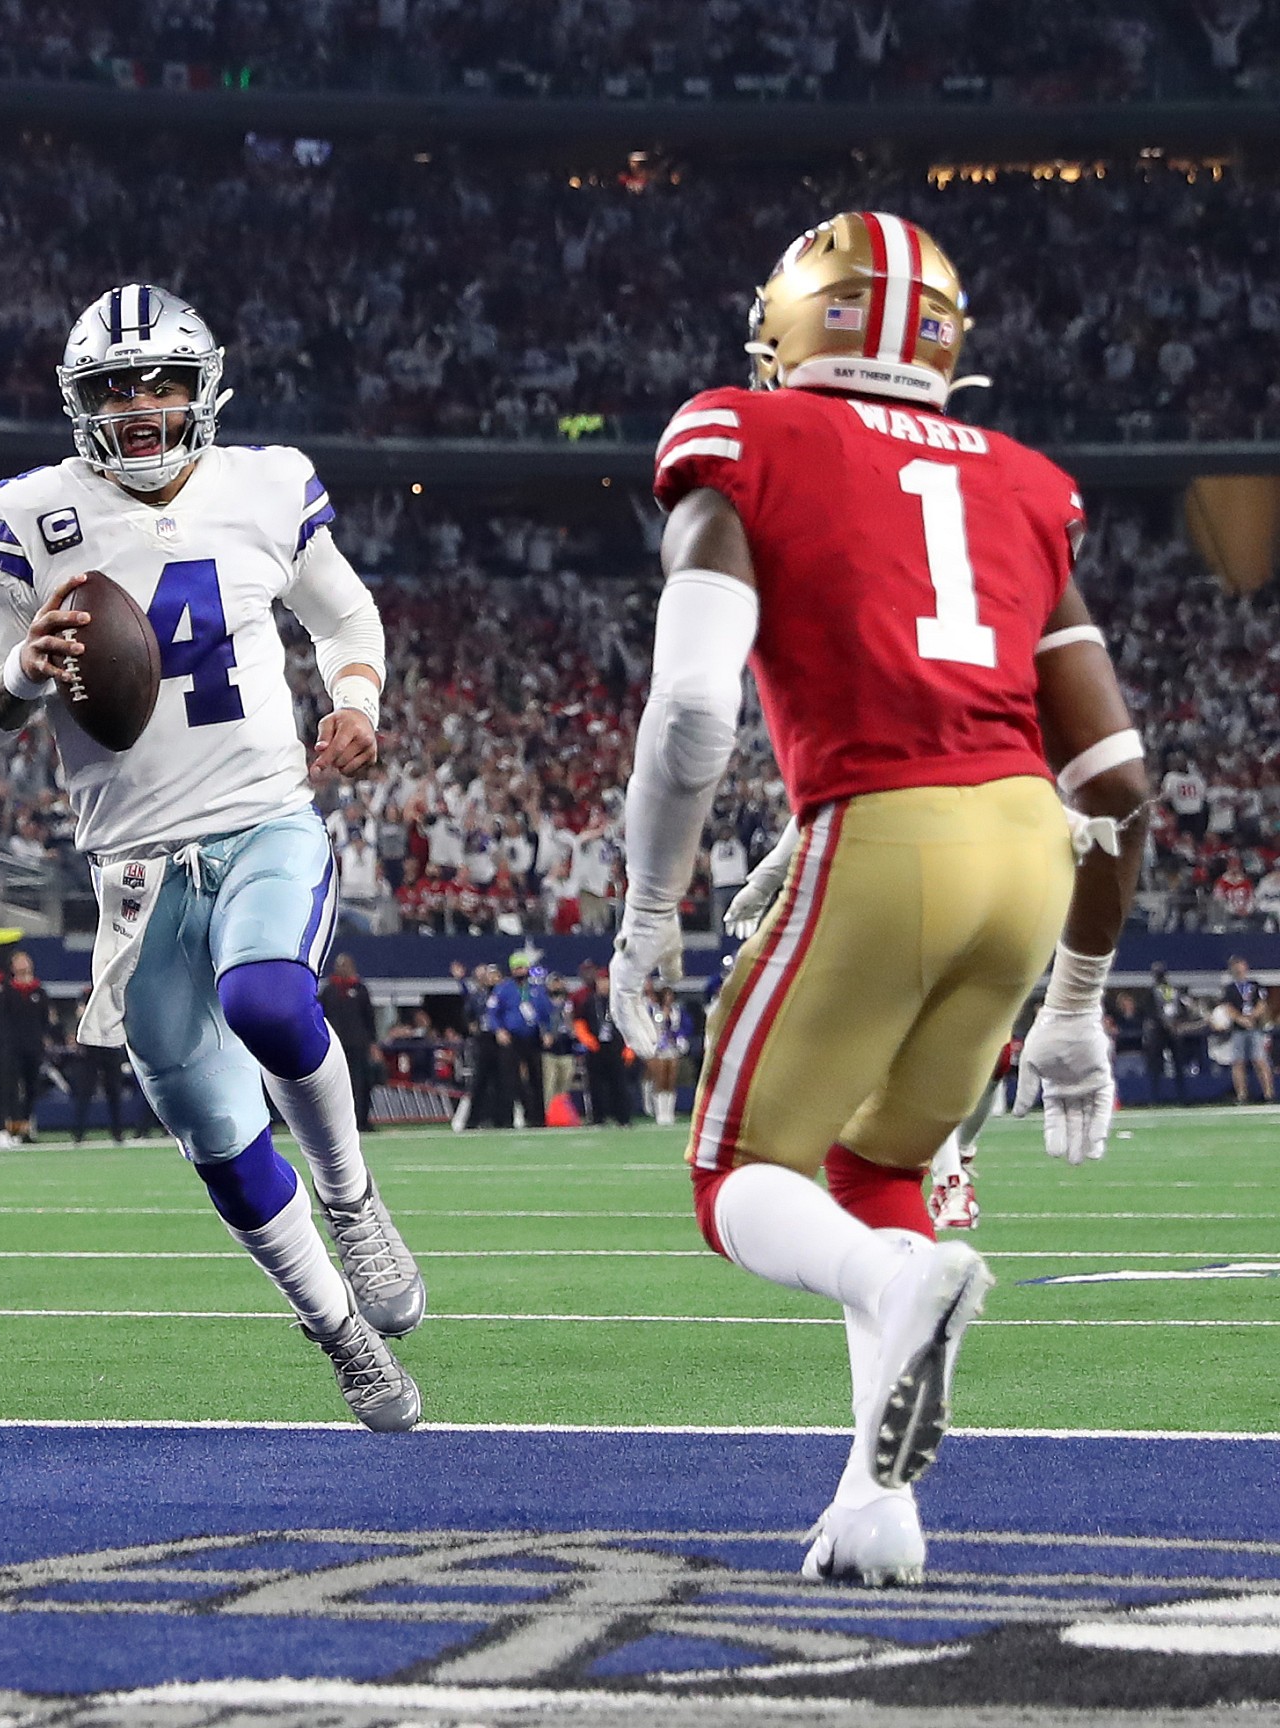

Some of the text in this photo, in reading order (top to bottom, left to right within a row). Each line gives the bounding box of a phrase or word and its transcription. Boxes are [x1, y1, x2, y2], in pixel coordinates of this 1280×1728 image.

[834, 367, 931, 390] SAY THEIR STORIES
[846, 399, 989, 454] WARD
[41, 509, 78, 543] C
[898, 458, 997, 669] 1
[146, 558, 246, 728] 4
[122, 907, 138, 922] NFL
